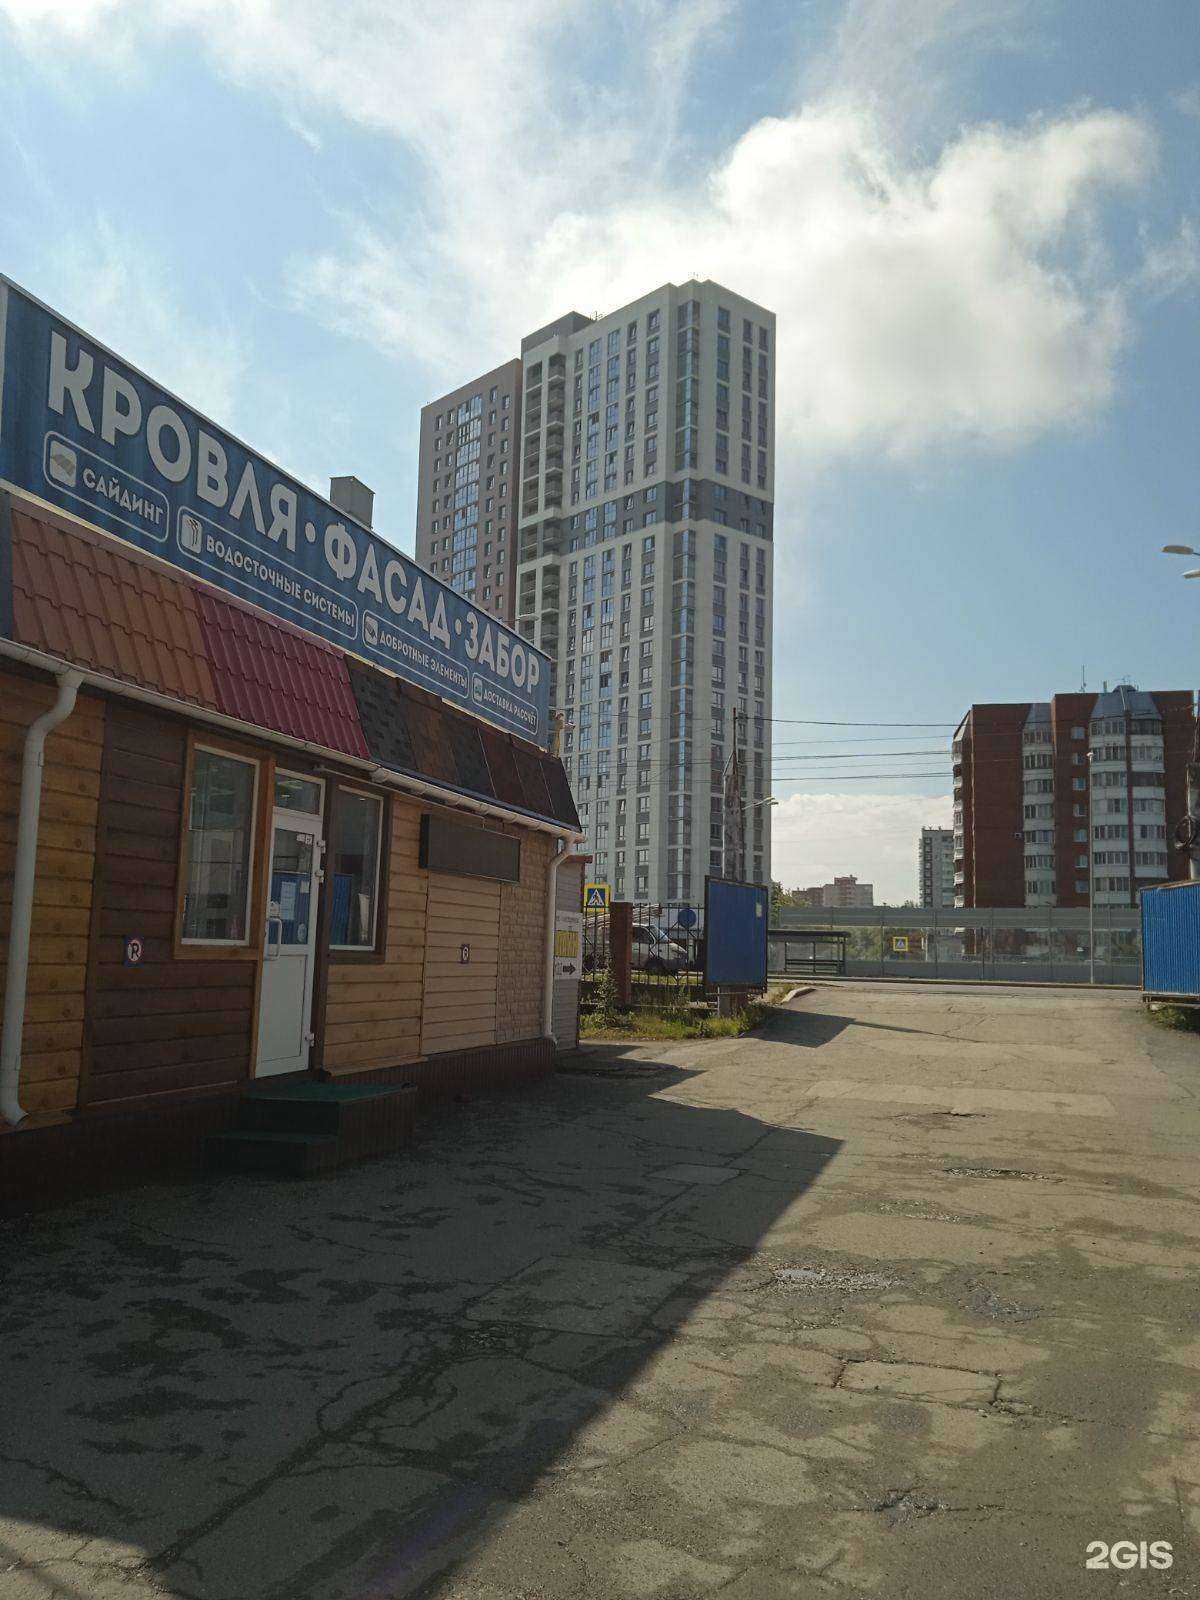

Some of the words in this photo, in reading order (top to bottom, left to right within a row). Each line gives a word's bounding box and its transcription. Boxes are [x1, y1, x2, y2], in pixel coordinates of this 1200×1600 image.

[48, 331, 297, 552] КРОВЛЯ
[324, 522, 450, 650] ФАСАД
[465, 611, 540, 694] ЗАБОР
[83, 468, 164, 525] САЙДИНГ
[206, 535, 301, 600] ВОДОСТОЧНЫЕ
[304, 589, 354, 628] СИСТЕМЫ
[380, 630, 430, 668] ДОБРОТНЫЕ
[431, 659, 468, 689] ЭЛЕМЕНТЫ
